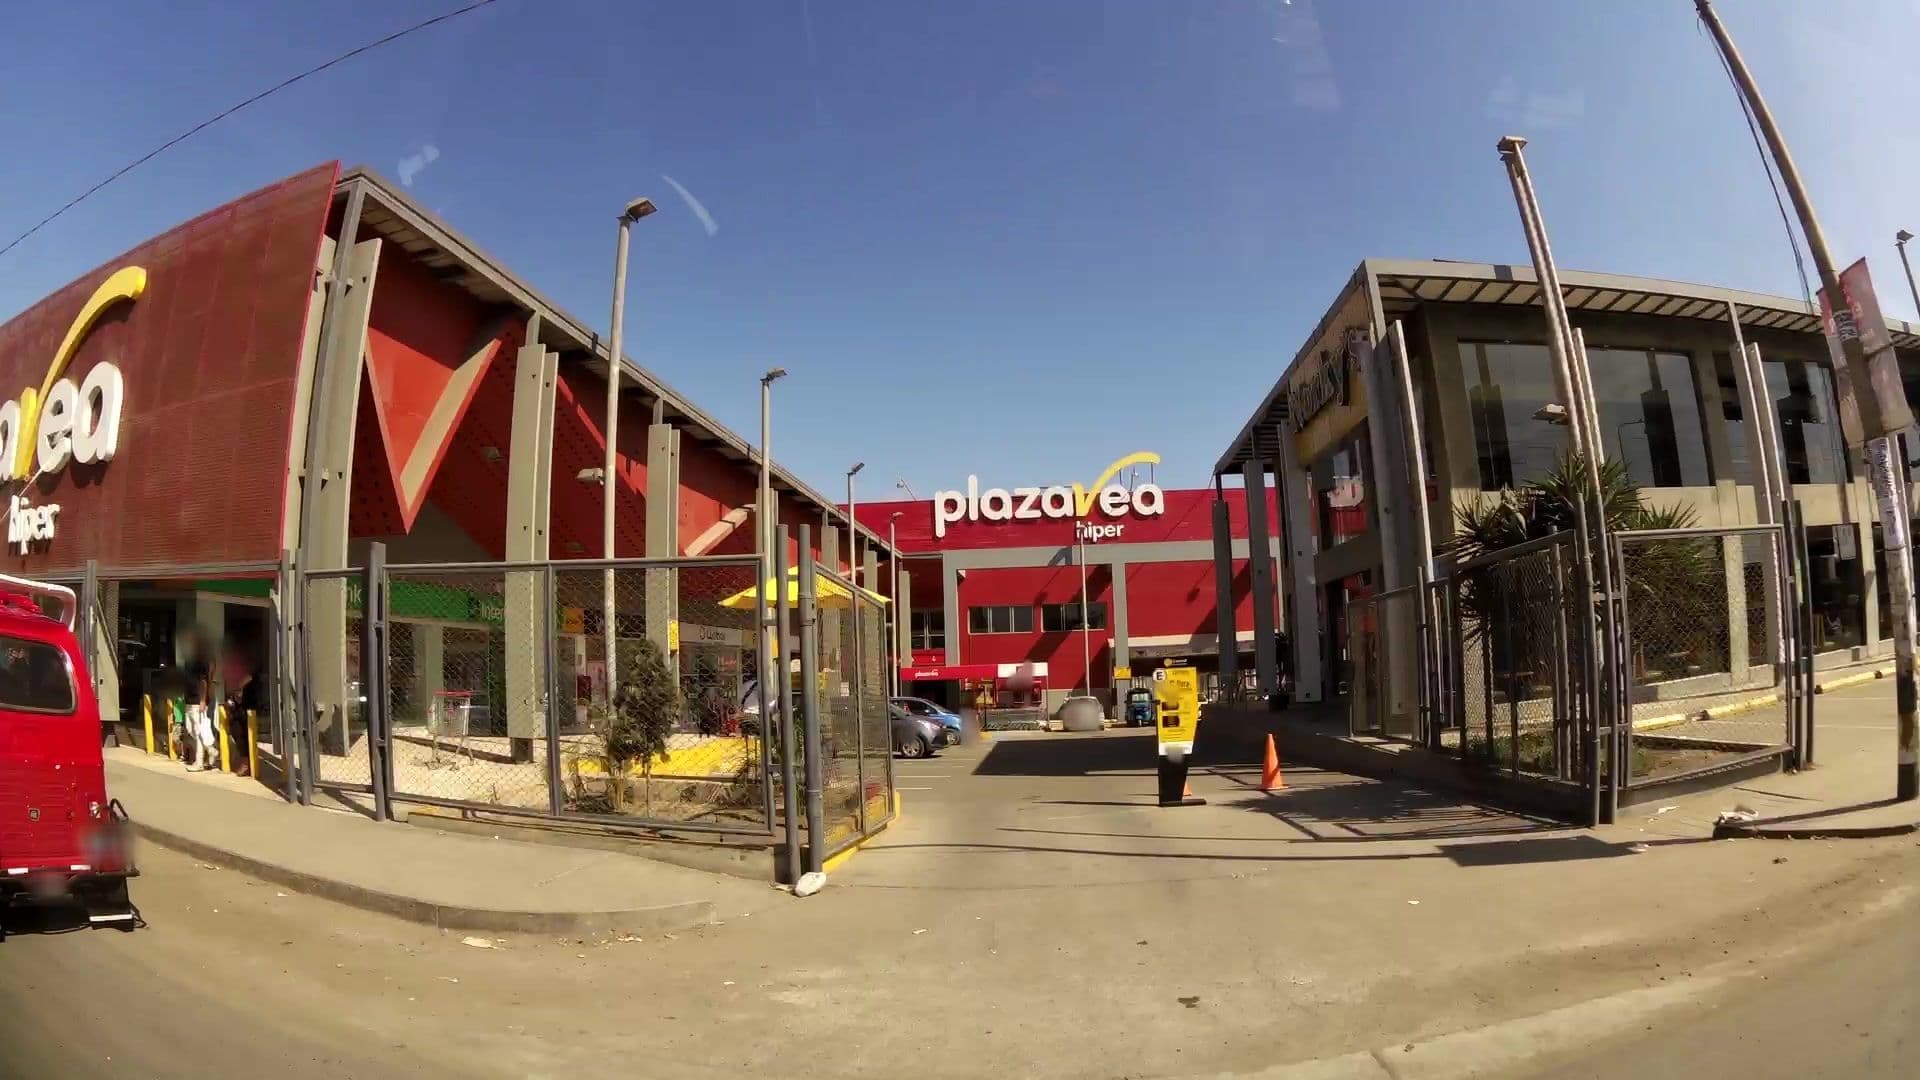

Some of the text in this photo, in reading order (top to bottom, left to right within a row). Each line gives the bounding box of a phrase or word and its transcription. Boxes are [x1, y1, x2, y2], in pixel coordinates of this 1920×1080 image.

[934, 452, 1164, 537] plazavea
[8, 495, 60, 554] hiper
[1076, 520, 1125, 542] hiper
